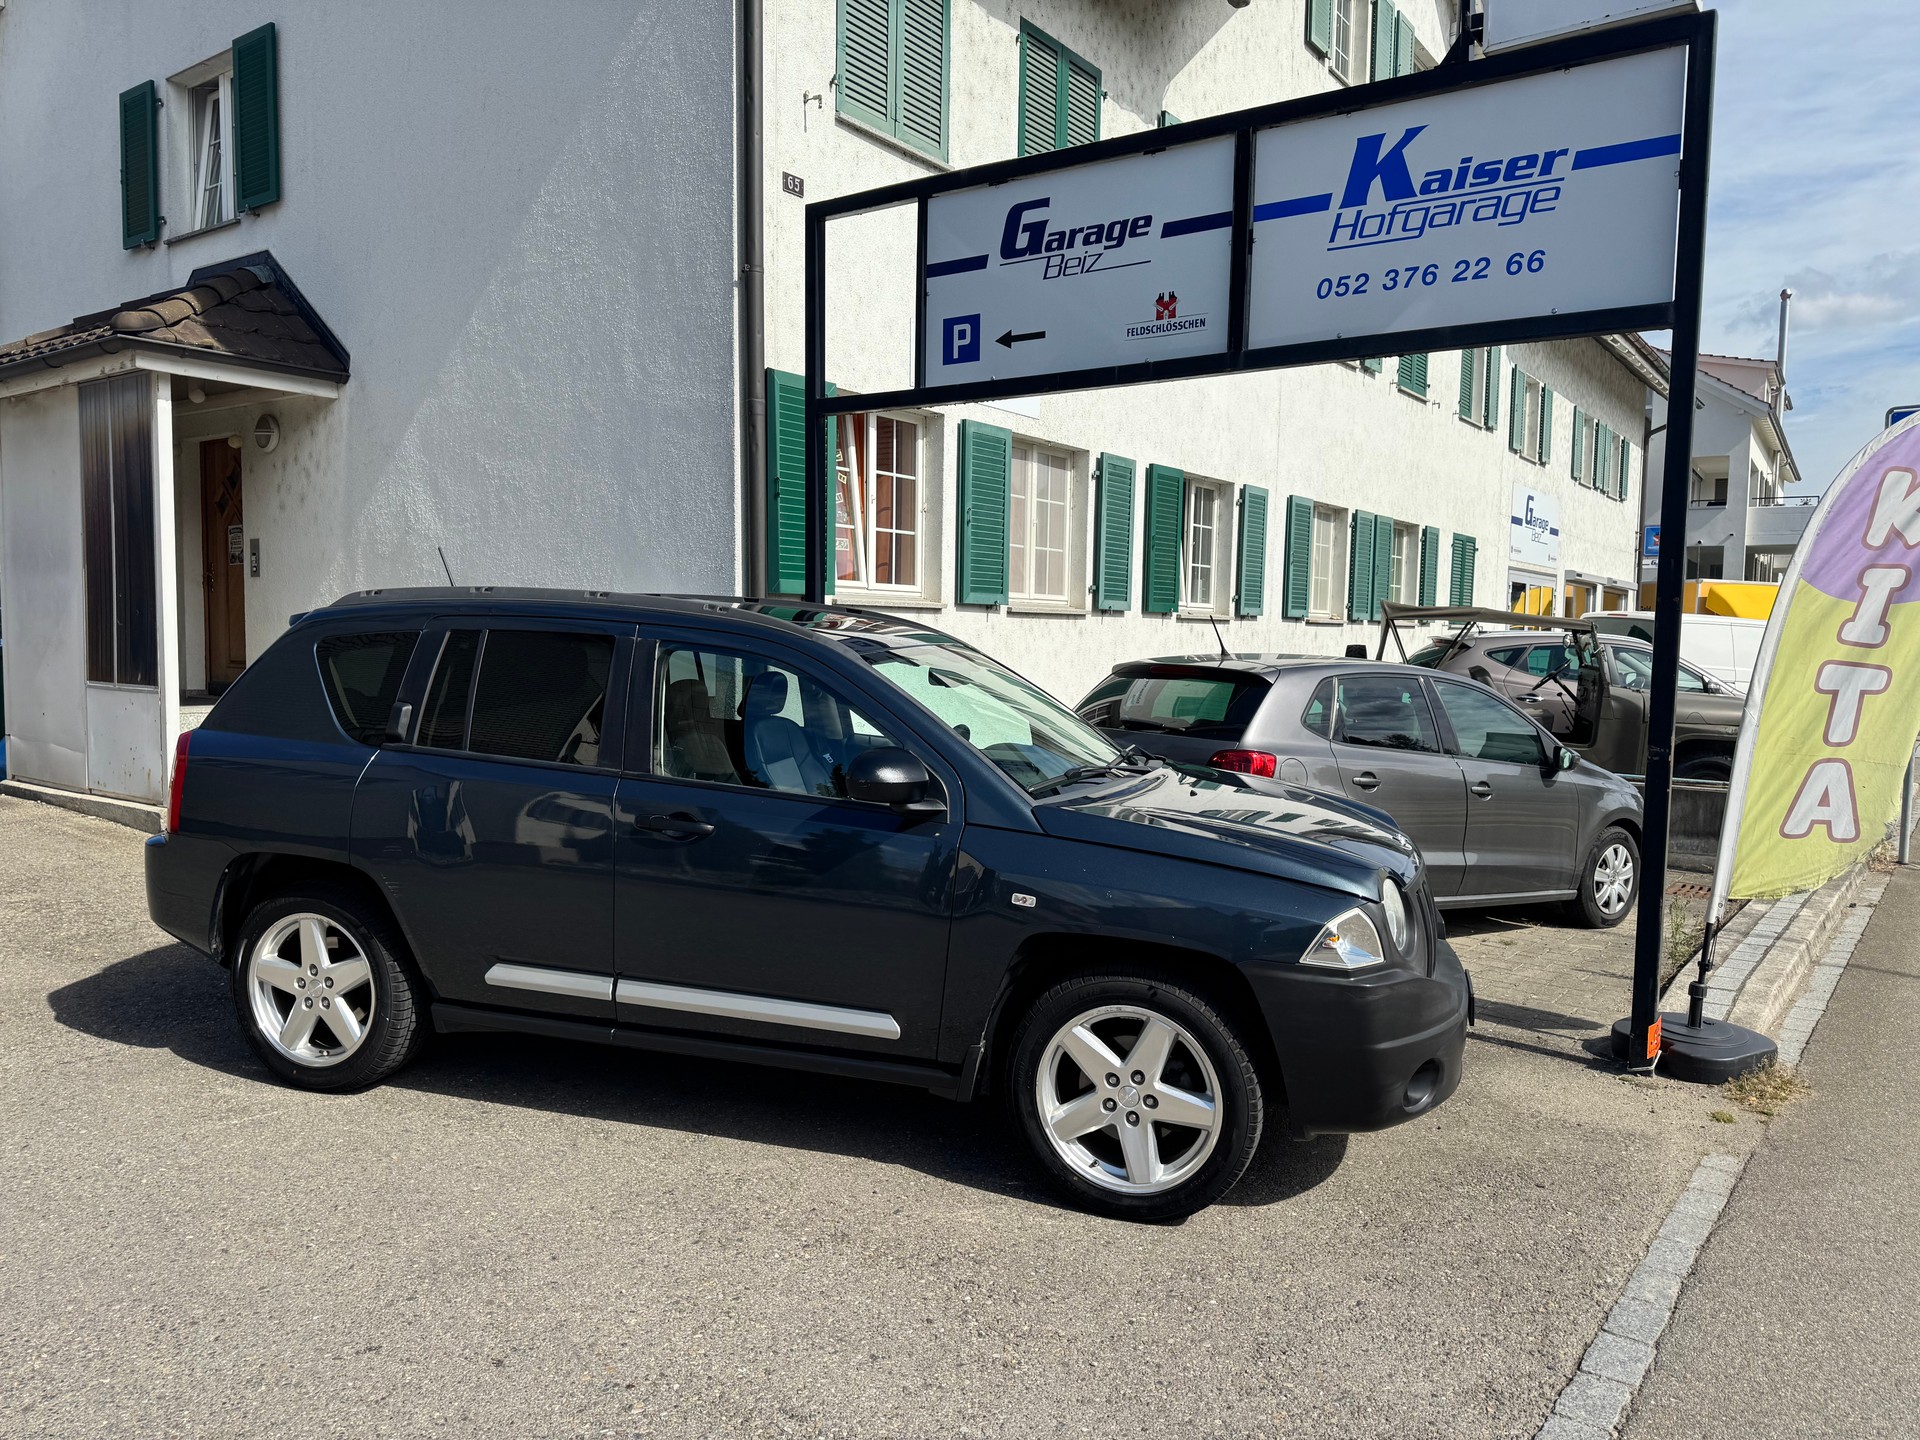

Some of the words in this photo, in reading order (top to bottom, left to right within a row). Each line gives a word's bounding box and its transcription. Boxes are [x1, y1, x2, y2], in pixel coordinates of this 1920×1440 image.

[787, 176, 800, 192] 65
[1338, 124, 1569, 209] Kaiser
[1000, 197, 1152, 260] Garage
[1327, 186, 1561, 251] Hofgarage
[1042, 251, 1104, 280] Beiz
[1316, 272, 1370, 299] 052
[1382, 263, 1439, 291] 376
[1451, 257, 1491, 283] 22
[1505, 249, 1546, 276] 66
[953, 323, 971, 359] P
[1126, 318, 1206, 337] FELDSCHLÖSSCHEN
[1525, 494, 1549, 533] Garage
[1779, 466, 1920, 842] KITA
